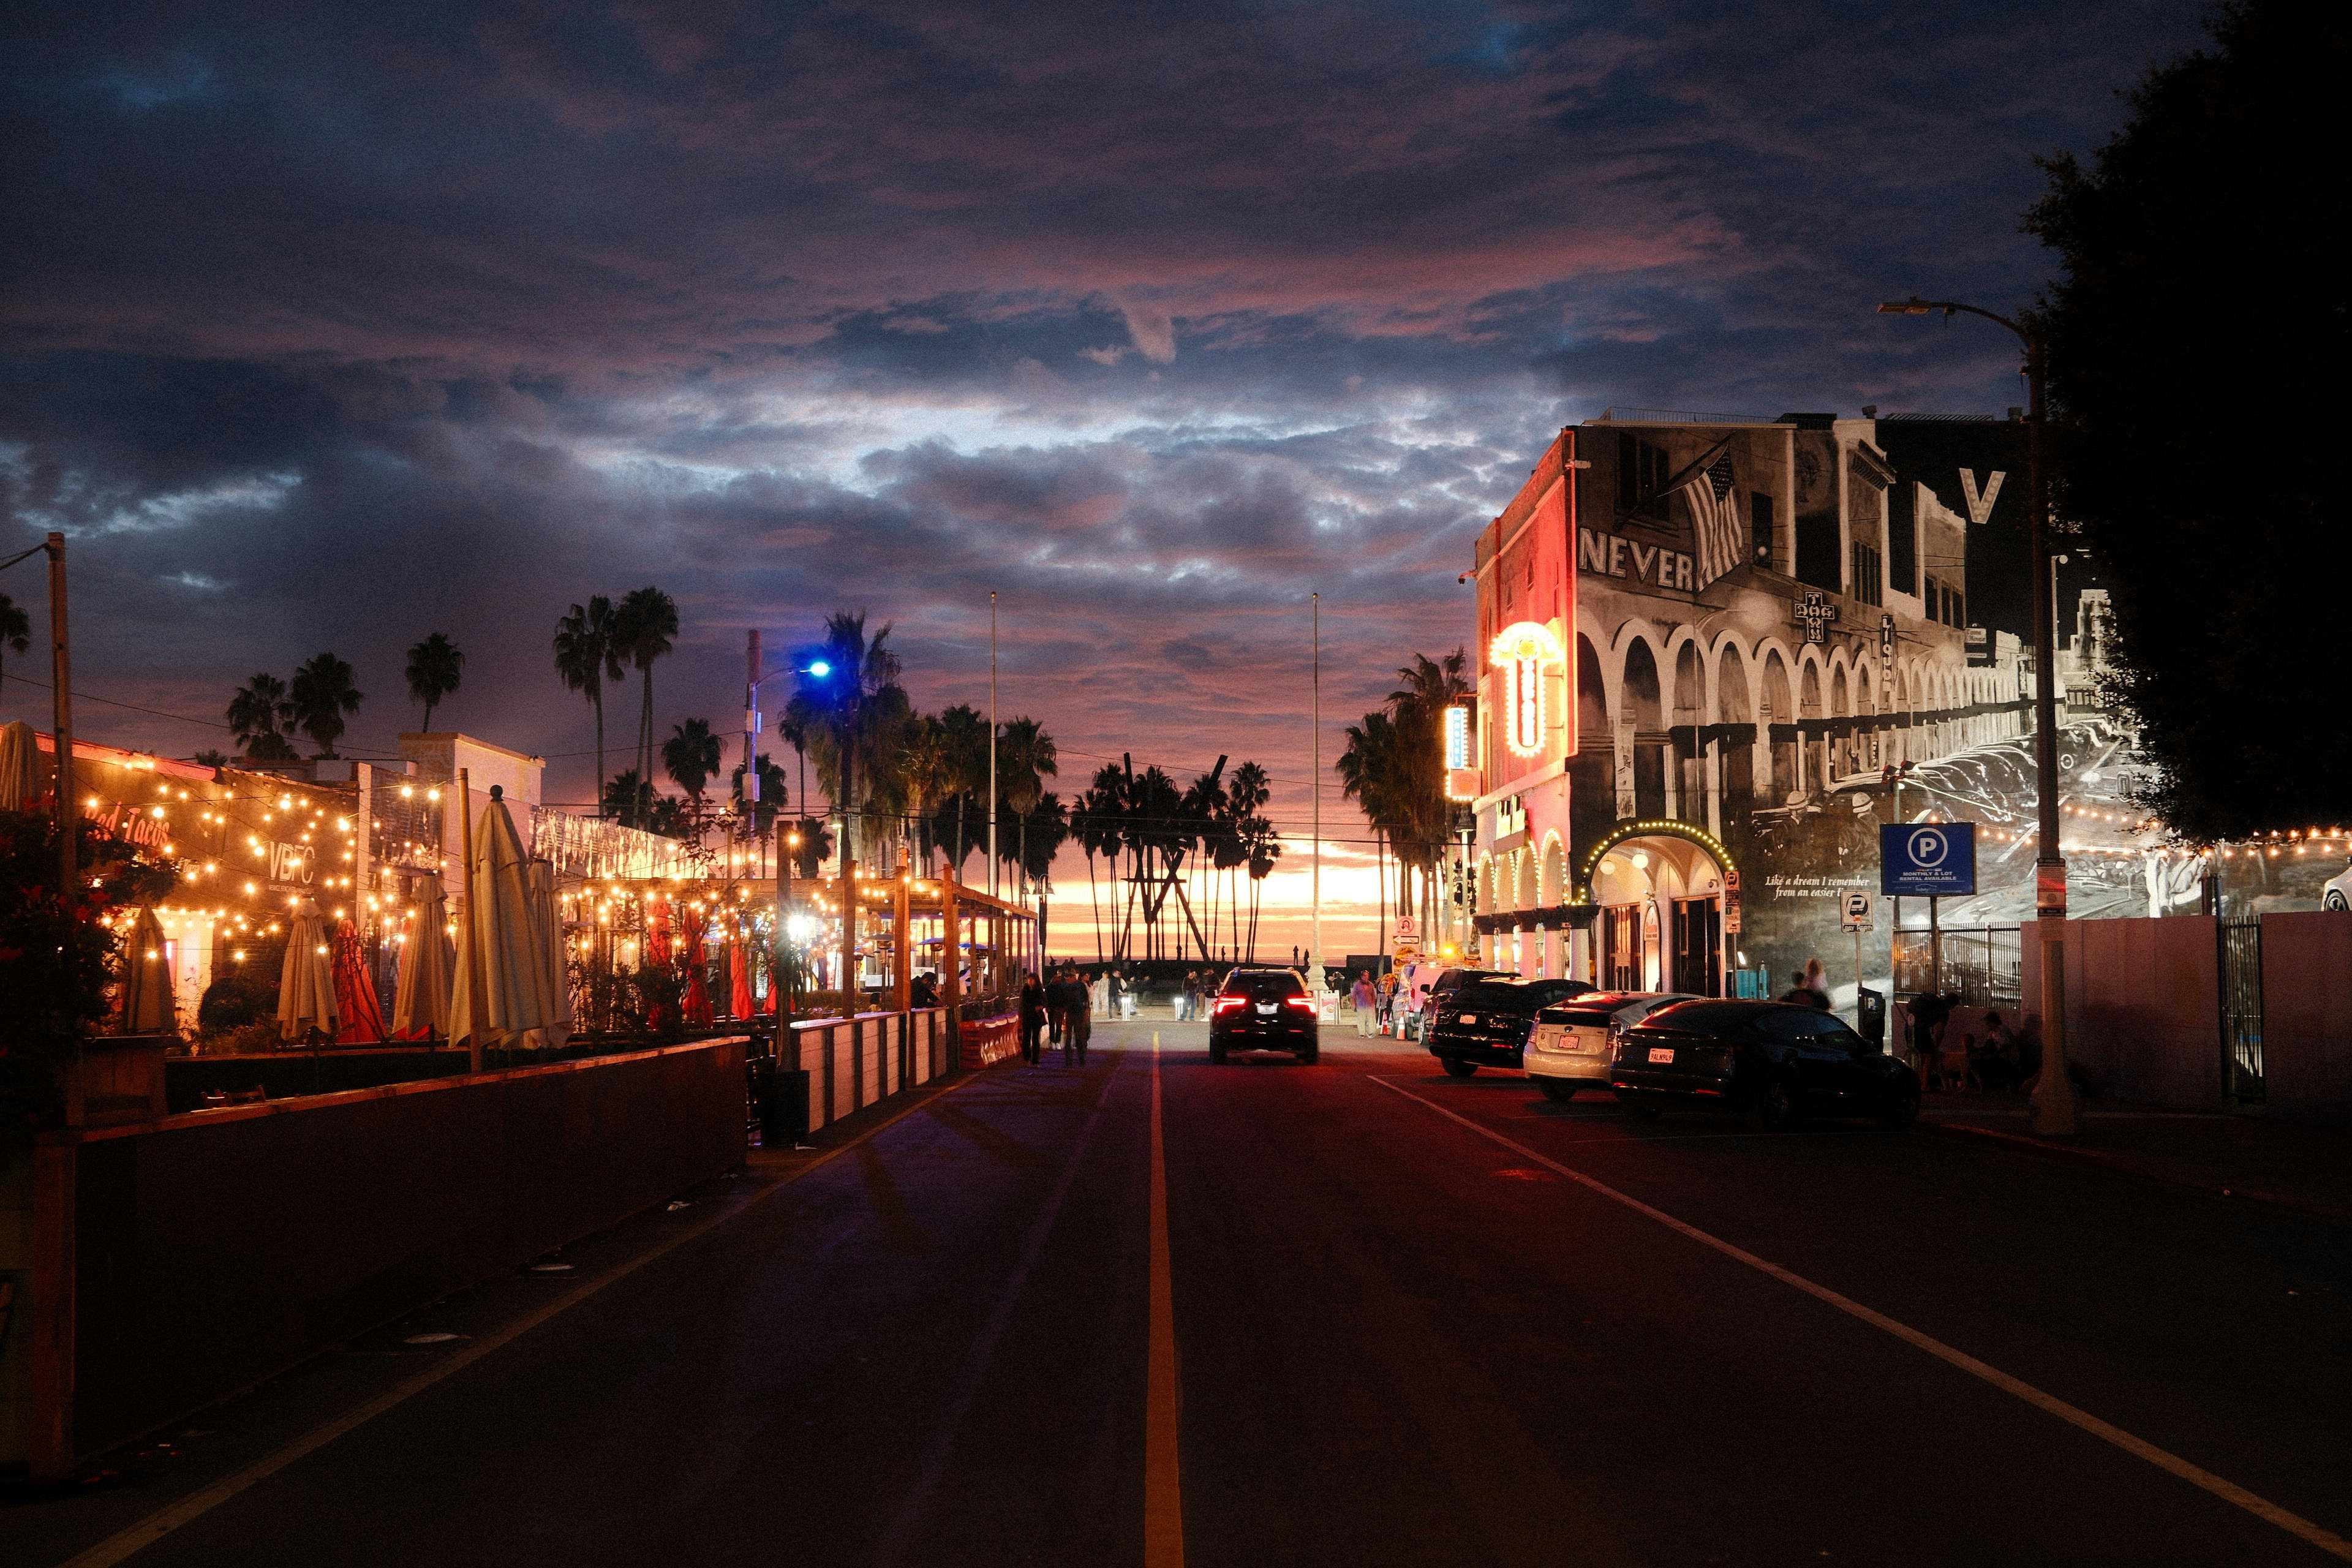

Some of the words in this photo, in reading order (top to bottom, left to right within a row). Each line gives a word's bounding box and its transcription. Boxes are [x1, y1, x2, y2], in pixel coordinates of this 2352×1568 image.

[1578, 527, 1693, 591] NEVER
[124, 807, 170, 848] Tacos
[270, 841, 315, 883] VBFC
[1920, 837, 1937, 858] P
[1765, 873, 1784, 886] Like
[1793, 874, 1820, 886] dream
[1828, 875, 1870, 886] remember
[1774, 886, 1796, 901] from
[1810, 888, 1835, 897] easier
